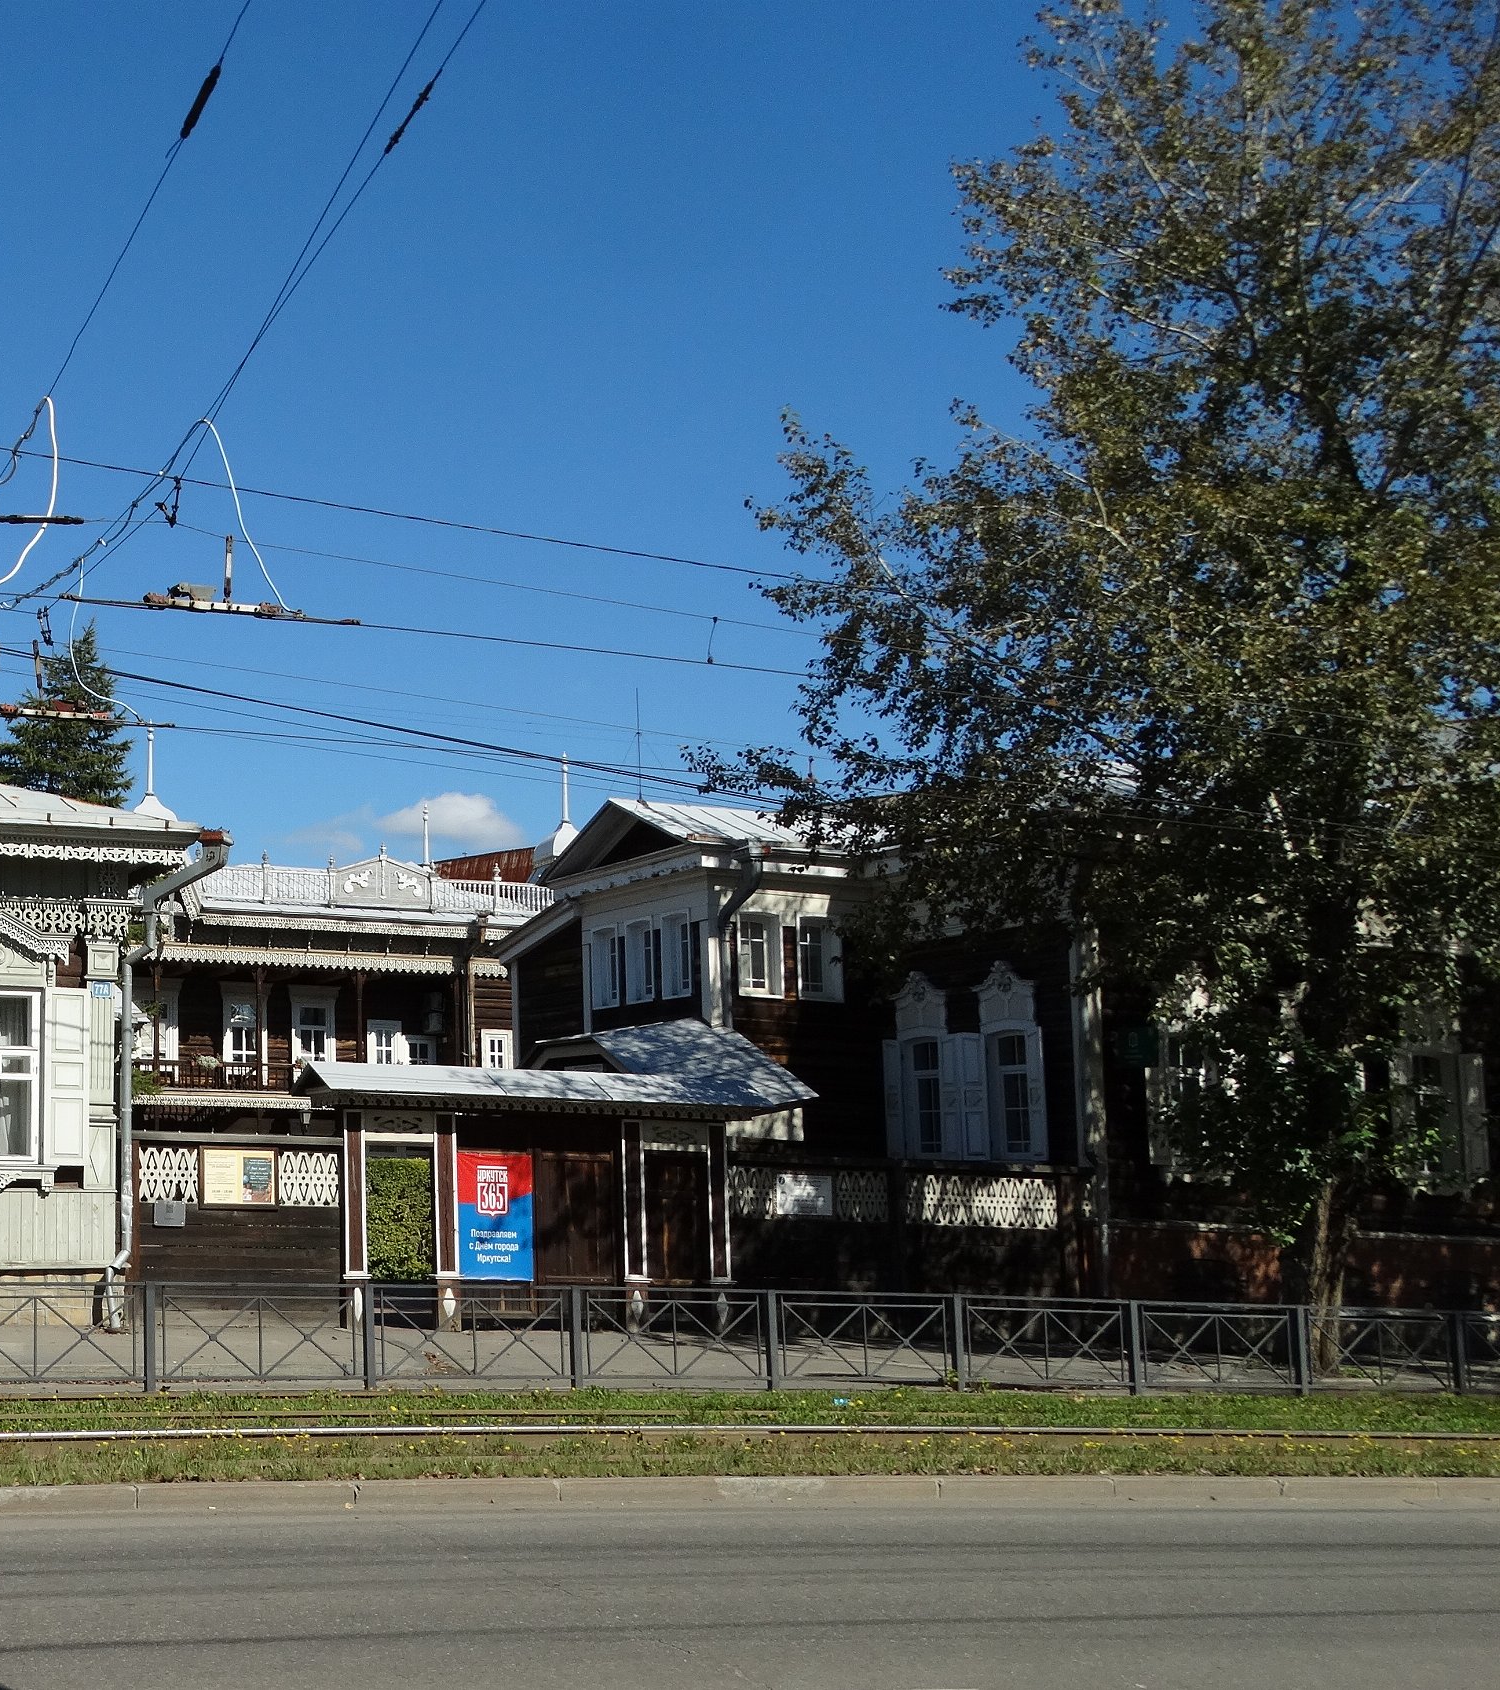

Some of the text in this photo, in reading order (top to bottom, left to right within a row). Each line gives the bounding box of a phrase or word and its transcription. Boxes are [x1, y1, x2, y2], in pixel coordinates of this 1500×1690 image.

[477, 1169, 508, 1183] ИРКУТСК
[481, 1183, 504, 1210] 365
[470, 1228, 517, 1239] Поздравляем
[469, 1241, 519, 1252] с Днём города
[477, 1253, 511, 1264] Иркутска!
